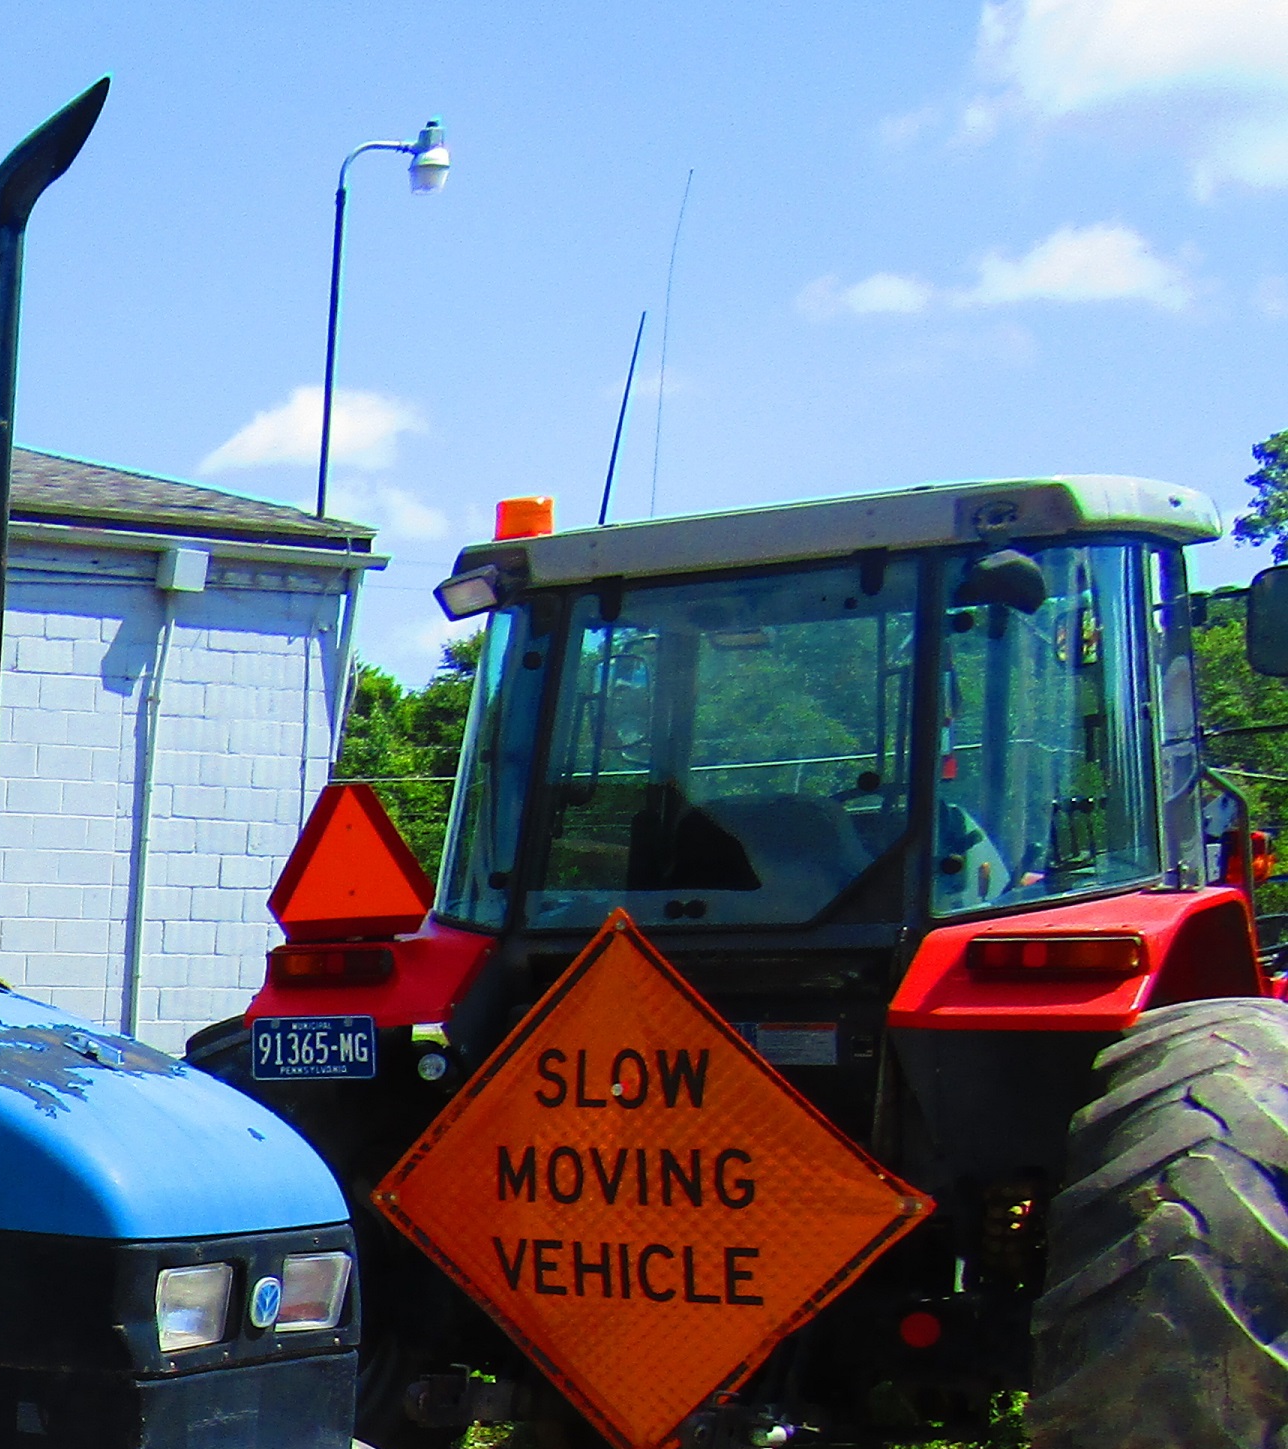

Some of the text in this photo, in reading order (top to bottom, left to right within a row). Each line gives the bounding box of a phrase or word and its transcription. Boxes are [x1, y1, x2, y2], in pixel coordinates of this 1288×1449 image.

[258, 1031, 369, 1066] 91365-MG
[279, 1065, 348, 1074] PENNSYLVANIA
[534, 1048, 710, 1110] SLOW
[496, 1145, 757, 1210] MOVING
[492, 1236, 765, 1307] VEHICLE
